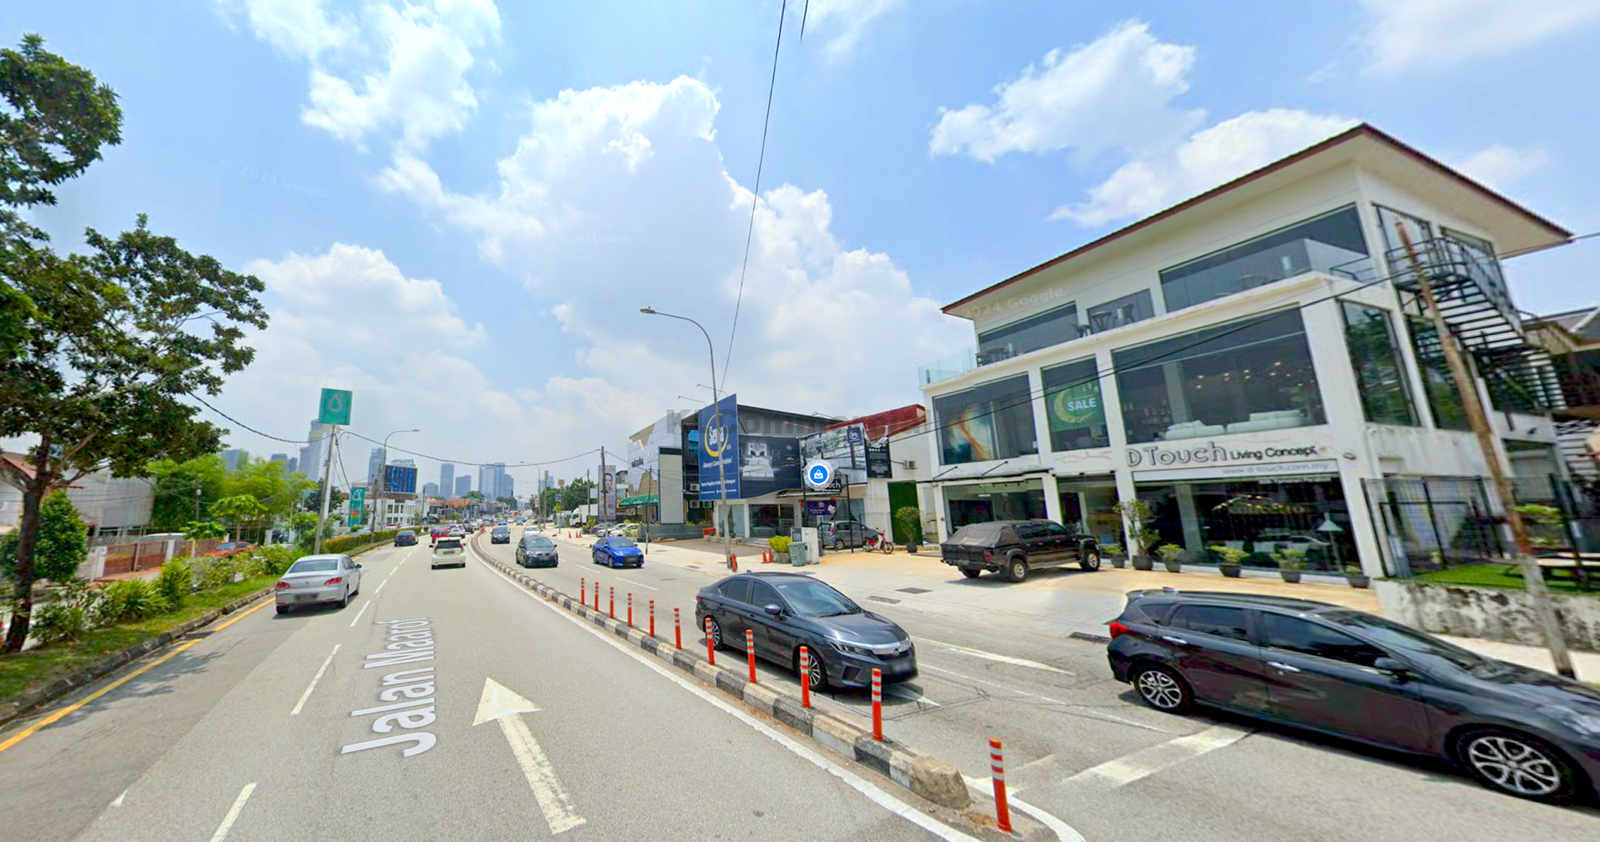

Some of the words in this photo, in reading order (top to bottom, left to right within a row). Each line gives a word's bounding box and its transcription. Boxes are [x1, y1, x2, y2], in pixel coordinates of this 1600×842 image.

[1067, 398, 1097, 411] SALE
[1126, 449, 1142, 467] D
[1143, 441, 1228, 466] Touch
[1229, 450, 1262, 461] Living
[1264, 445, 1318, 457] Concept
